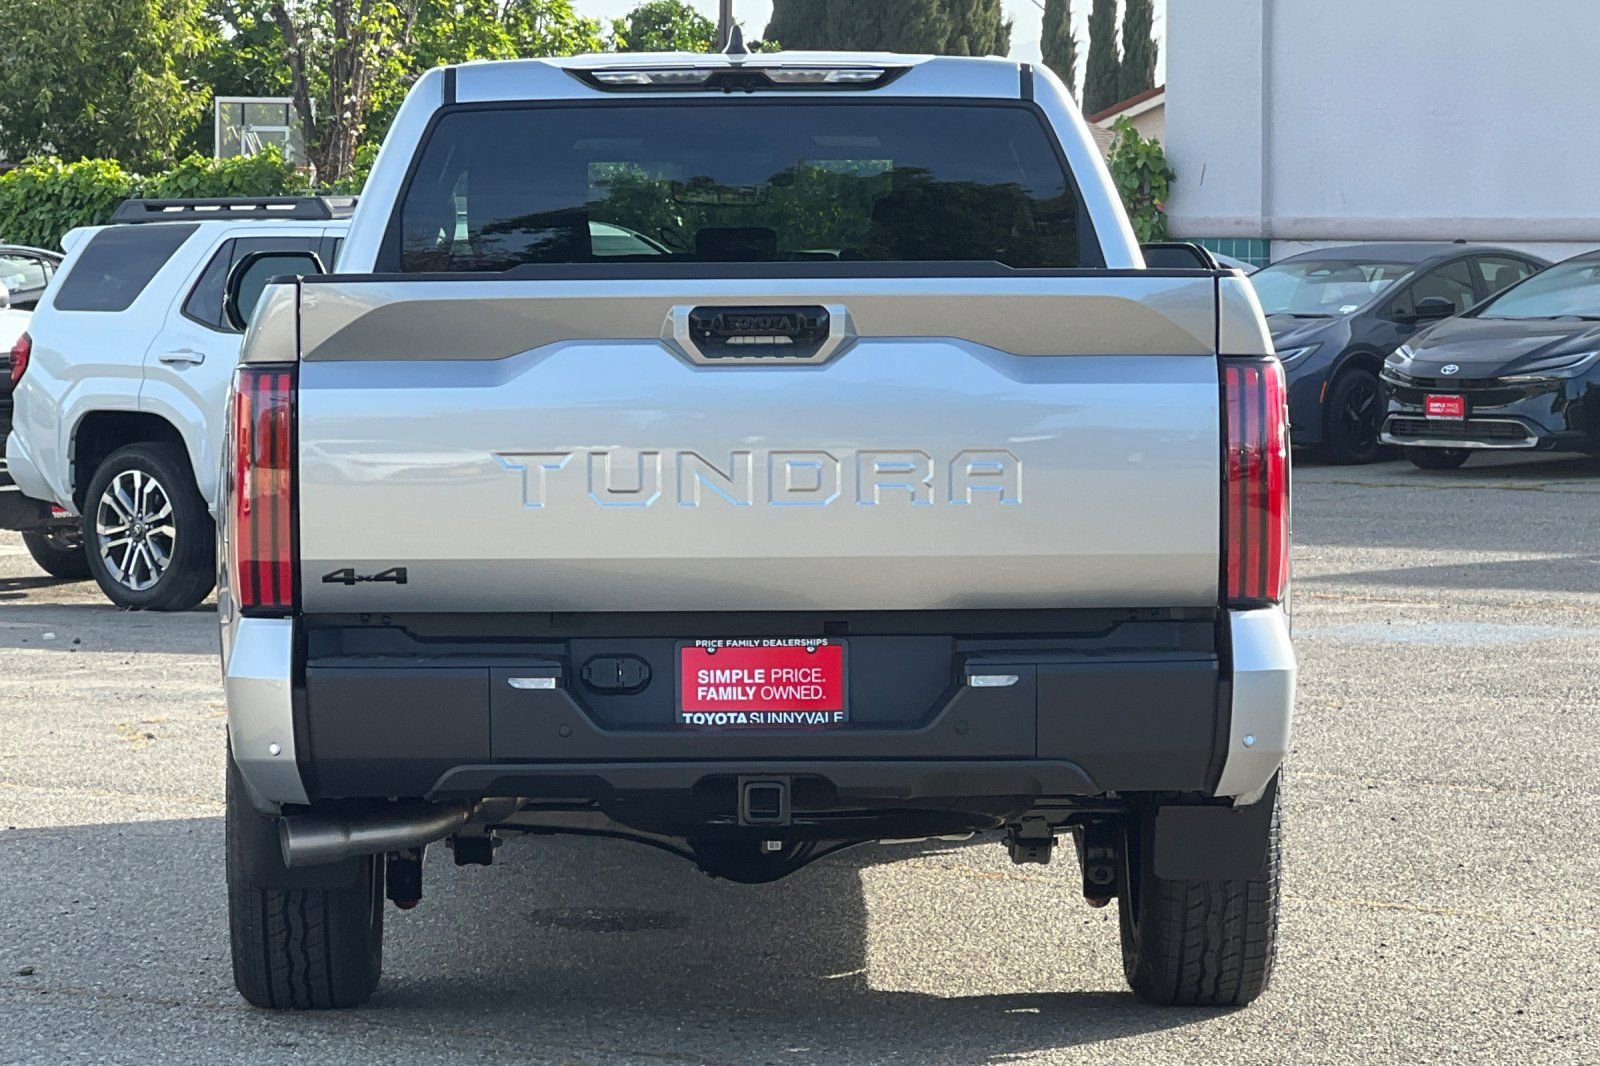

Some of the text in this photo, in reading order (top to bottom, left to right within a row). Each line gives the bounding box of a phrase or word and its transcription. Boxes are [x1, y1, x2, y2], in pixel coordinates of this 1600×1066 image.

[492, 449, 1023, 508] TUNDRA
[695, 638, 828, 648] PRICE FAMILY DEALERSHIPS
[697, 668, 826, 684] SIMPLE PRICE.
[697, 685, 827, 701] FAMILY OWNED.
[682, 713, 747, 725] TOYOTA
